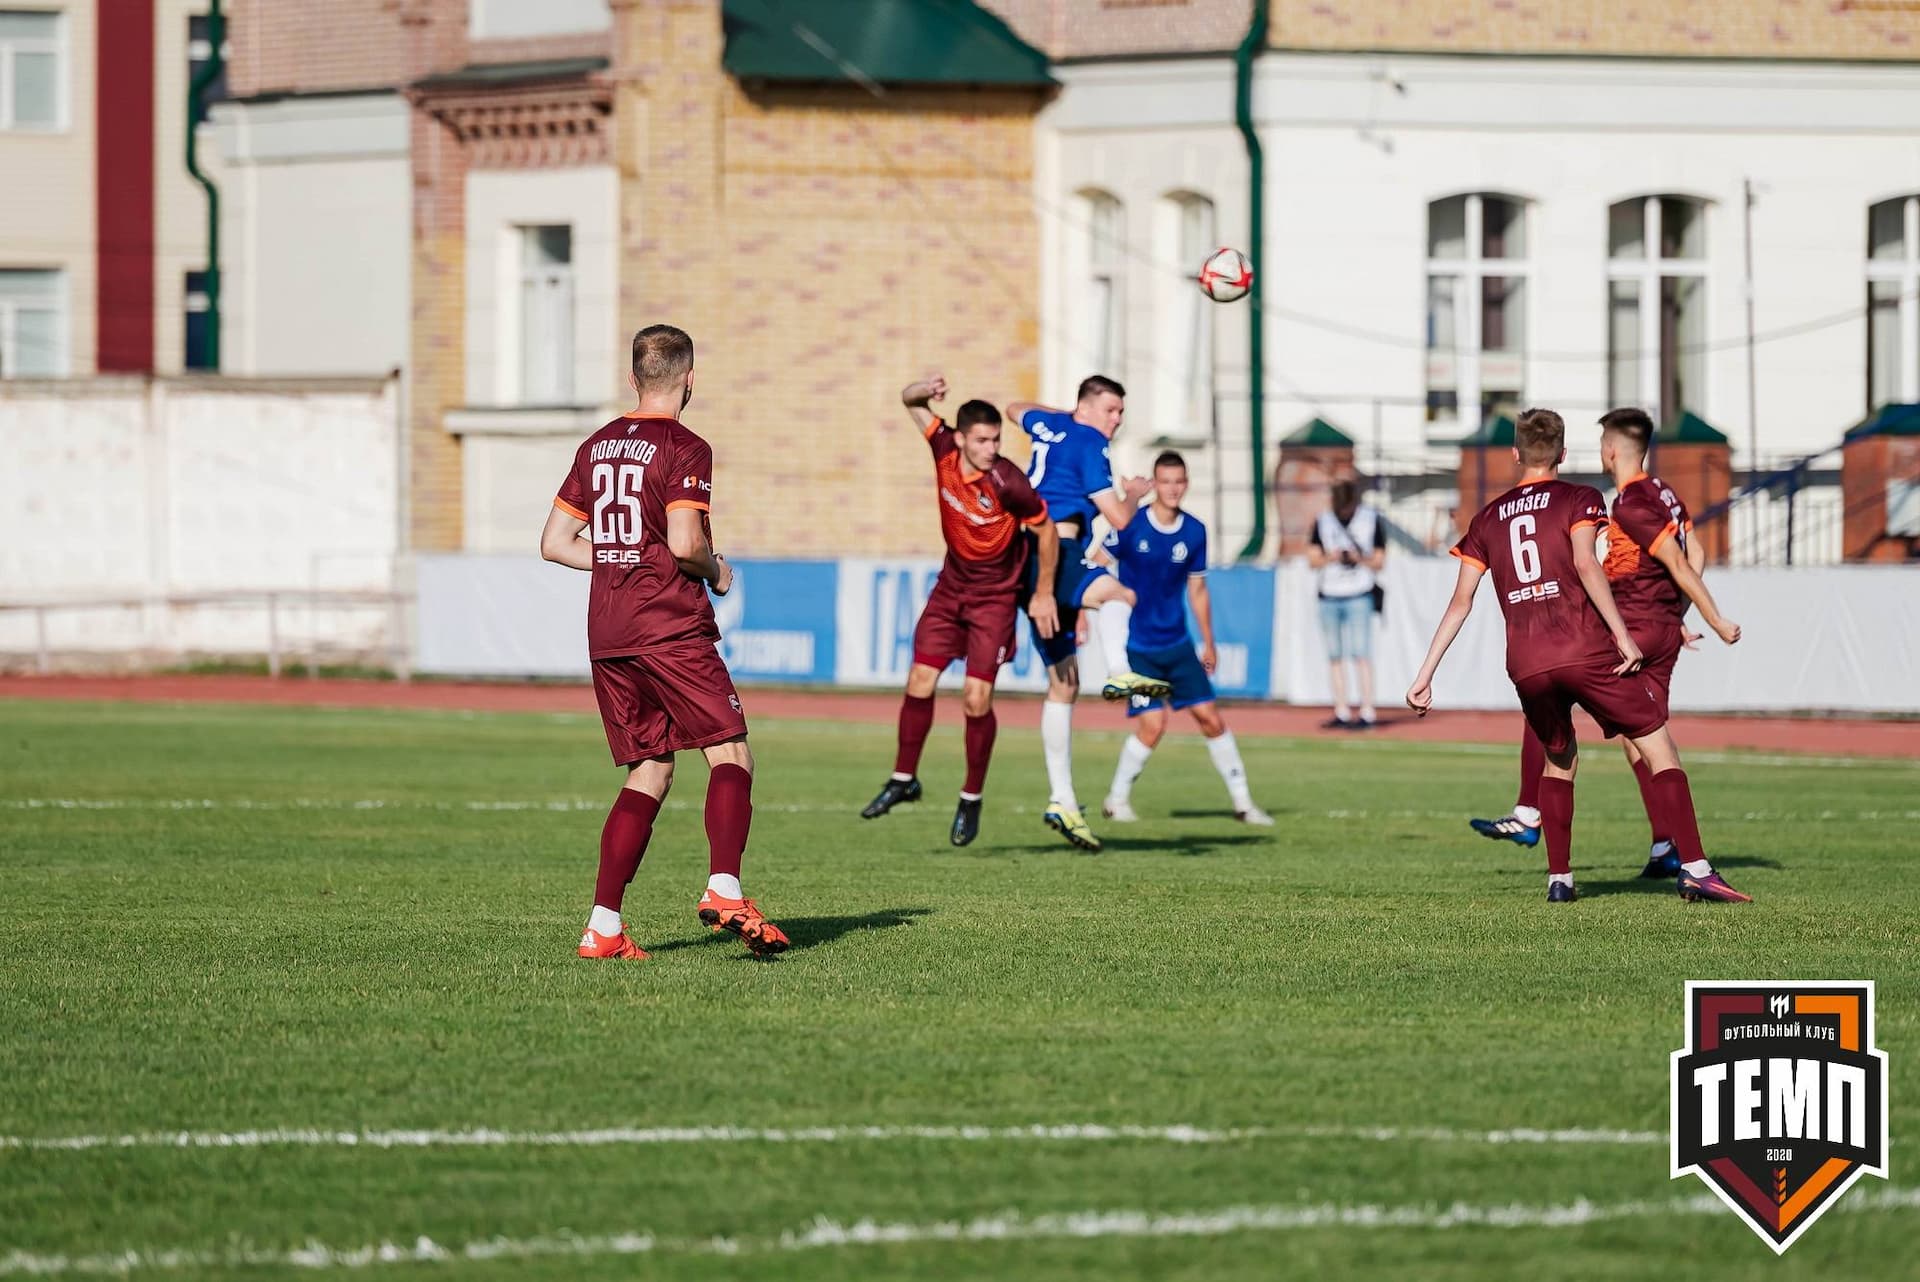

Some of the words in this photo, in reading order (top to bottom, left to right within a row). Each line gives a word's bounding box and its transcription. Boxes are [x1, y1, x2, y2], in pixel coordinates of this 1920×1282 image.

[590, 439, 657, 465] НОВИЧКОВ
[592, 463, 645, 545] 25
[1498, 492, 1551, 521] КНЯЗЕВ
[596, 549, 641, 564] SEUS
[1509, 514, 1542, 584] 6
[1507, 580, 1560, 605] SEUS
